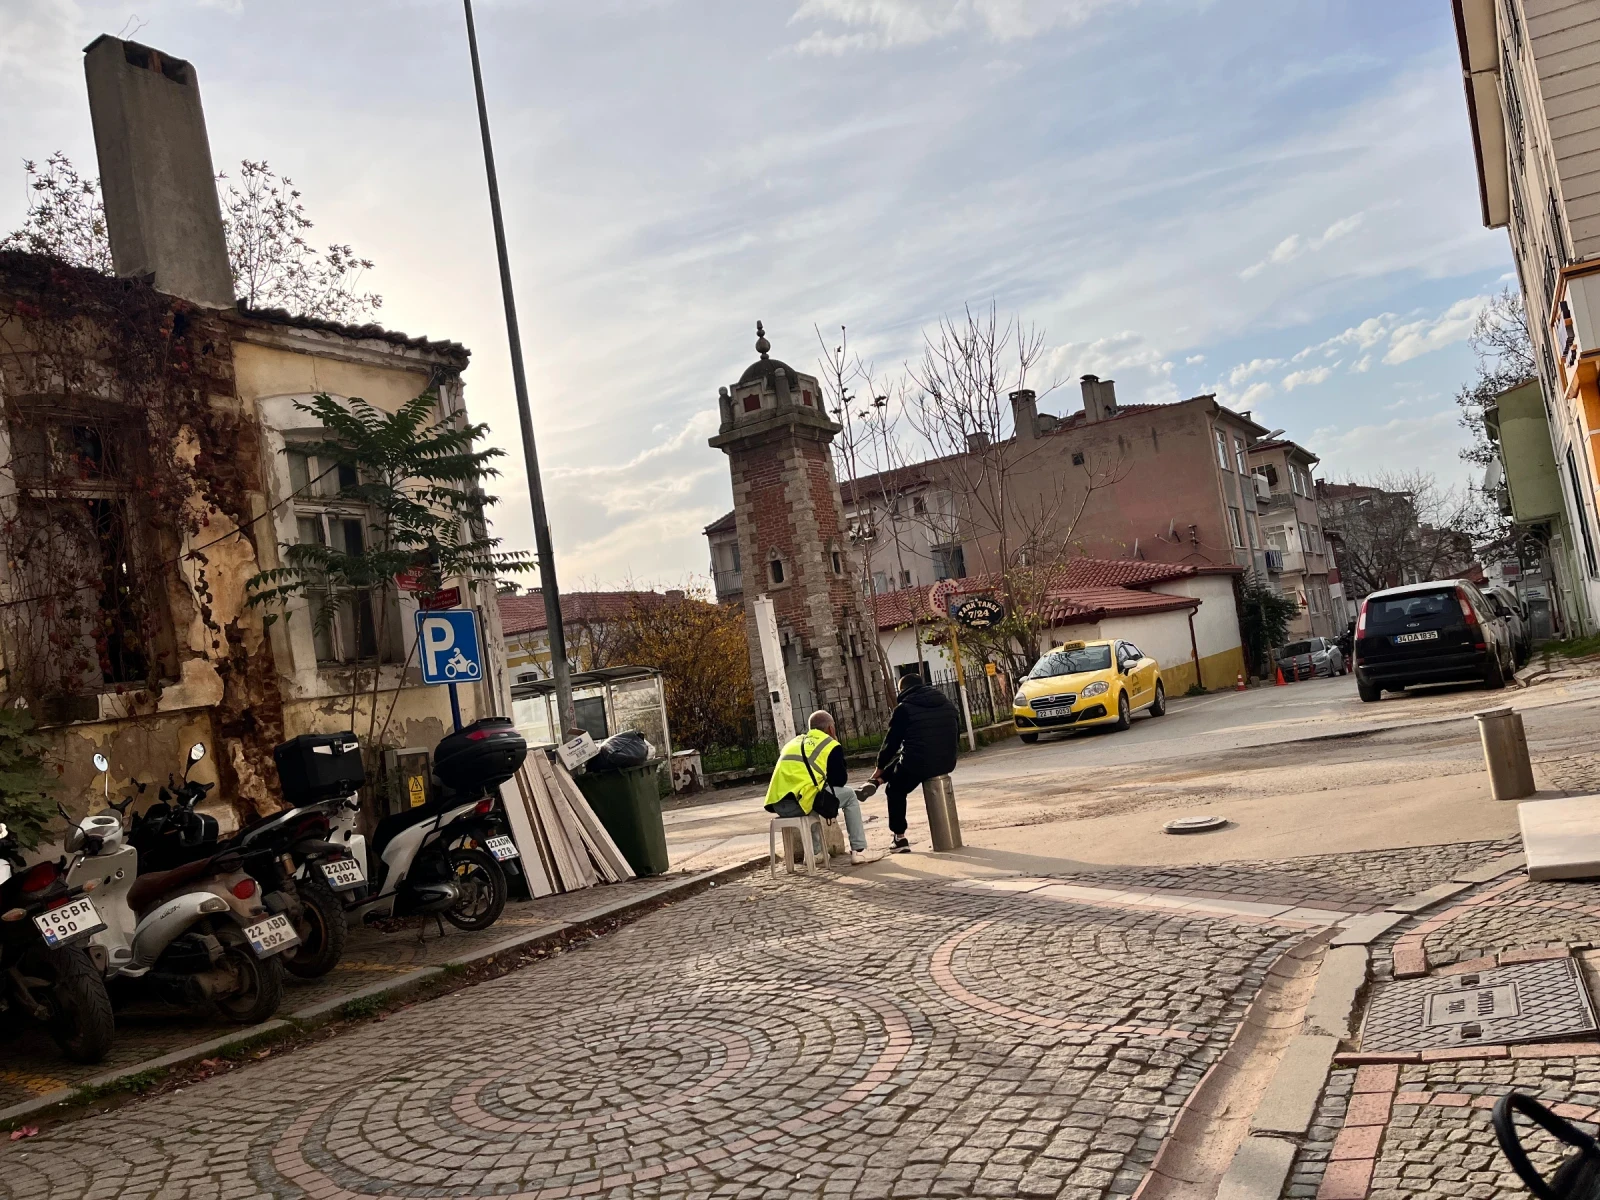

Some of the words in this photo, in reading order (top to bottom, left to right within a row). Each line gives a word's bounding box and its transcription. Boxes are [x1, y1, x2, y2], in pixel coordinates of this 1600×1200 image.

[958, 600, 976, 617] PARK
[968, 609, 990, 618] 7/24
[422, 617, 455, 676] P
[337, 872, 357, 883] 982
[57, 921, 78, 936] 90
[248, 926, 265, 939] 22
[262, 932, 285, 947] 592
